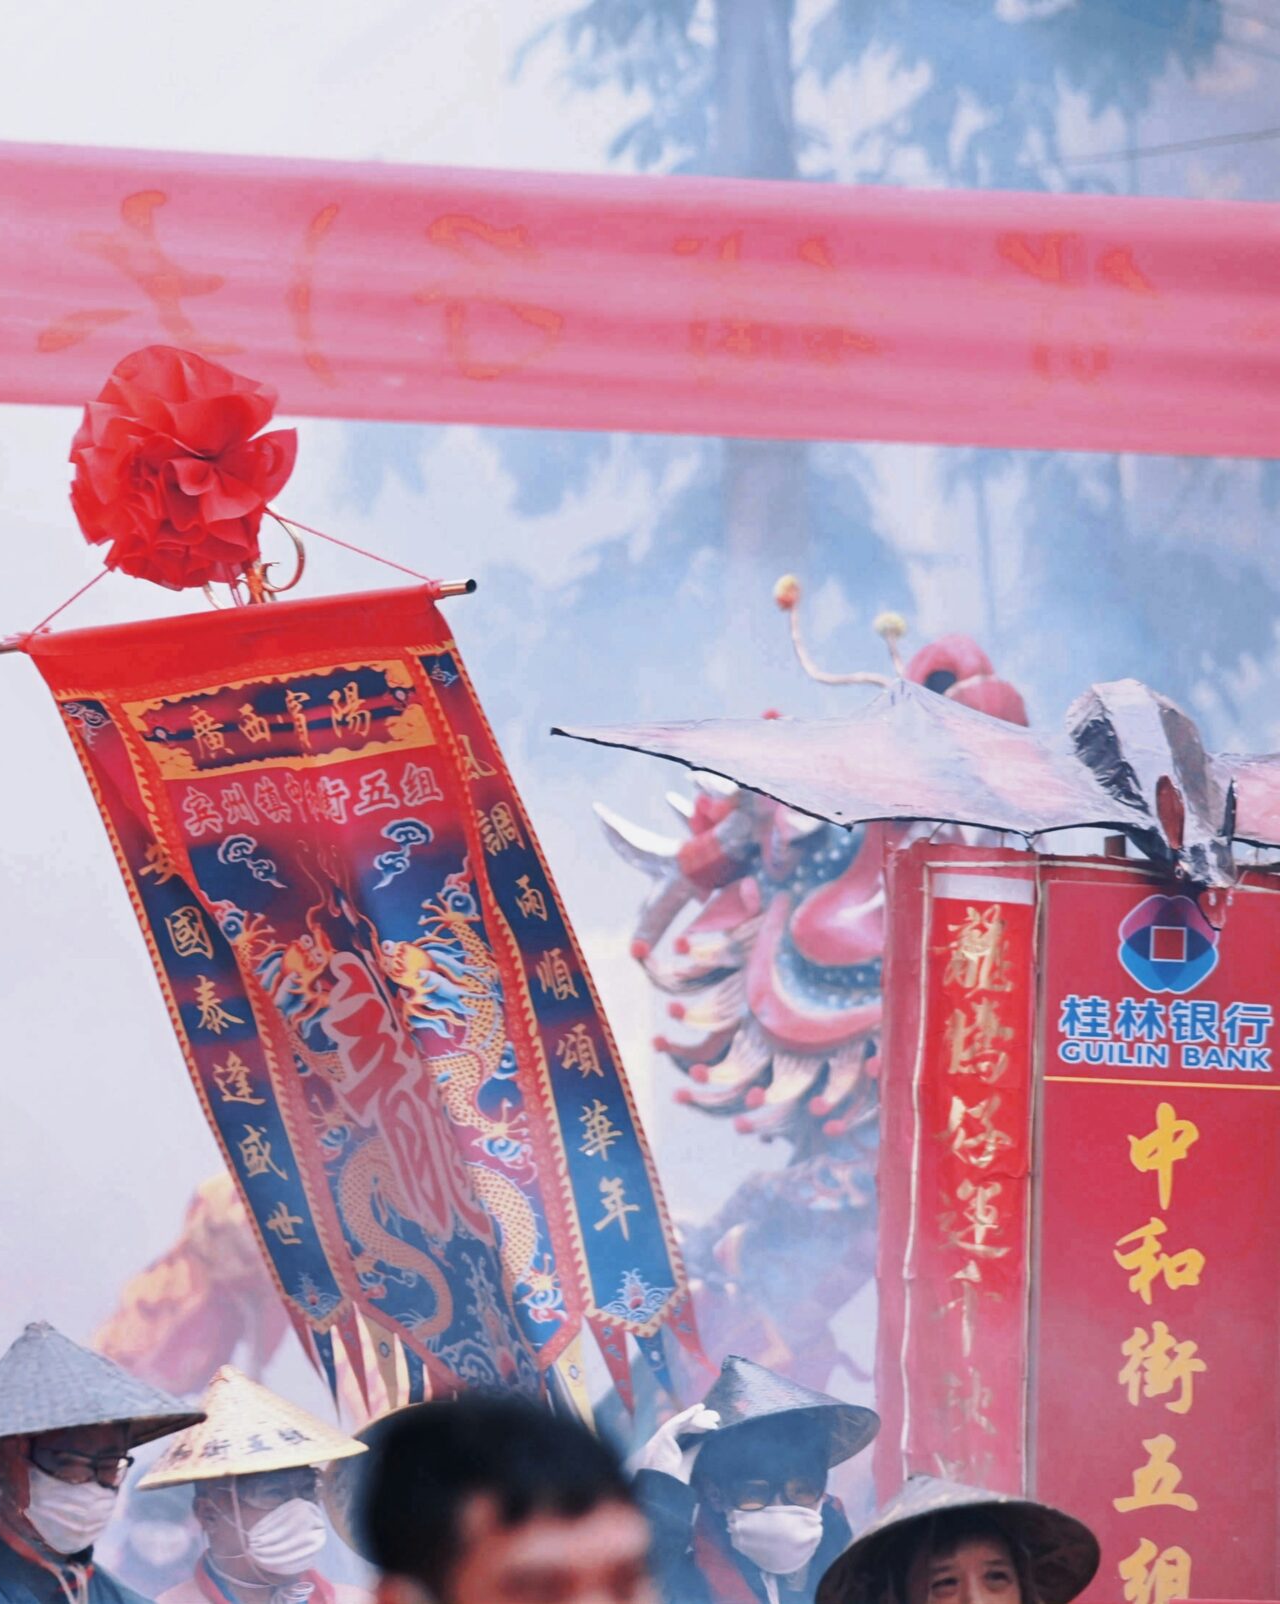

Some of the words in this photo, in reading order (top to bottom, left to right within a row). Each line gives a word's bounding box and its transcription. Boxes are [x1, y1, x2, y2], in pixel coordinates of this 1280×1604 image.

[1058, 994, 1274, 1047] 桂林银行
[1059, 1041, 1168, 1068] GUILIN
[1181, 1046, 1272, 1072] BANK
[1113, 1103, 1207, 1603] 中和街五组
